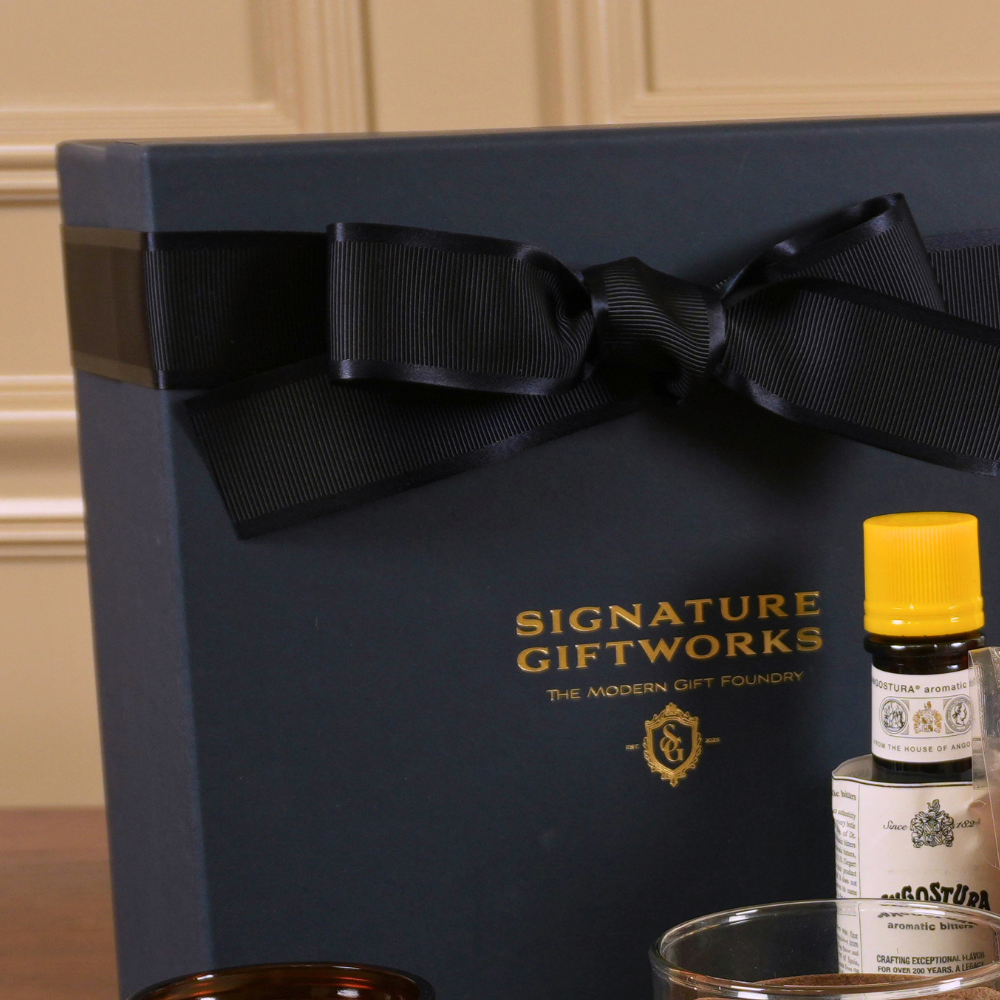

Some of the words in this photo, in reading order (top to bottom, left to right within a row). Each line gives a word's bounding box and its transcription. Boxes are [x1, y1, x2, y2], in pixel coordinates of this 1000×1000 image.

[516, 591, 821, 637] SIGNATURE
[516, 626, 824, 673] GIFTWORKS
[546, 688, 580, 701] THE
[587, 681, 668, 699] MODERN
[674, 677, 714, 691] GIFT
[721, 671, 805, 688] FOUNDRY
[924, 681, 967, 693] aromatic
[888, 744, 901, 752] THE
[904, 745, 933, 753] HOUSE
[882, 819, 908, 831] Since
[887, 922, 936, 931] aromatic
[940, 922, 974, 931] bitters
[876, 954, 910, 965] CRAFTING
[911, 954, 961, 965] EXCEPTIONAL
[877, 965, 891, 973] FOR
[893, 965, 911, 974] OVER
[927, 965, 954, 974] YEARS.
